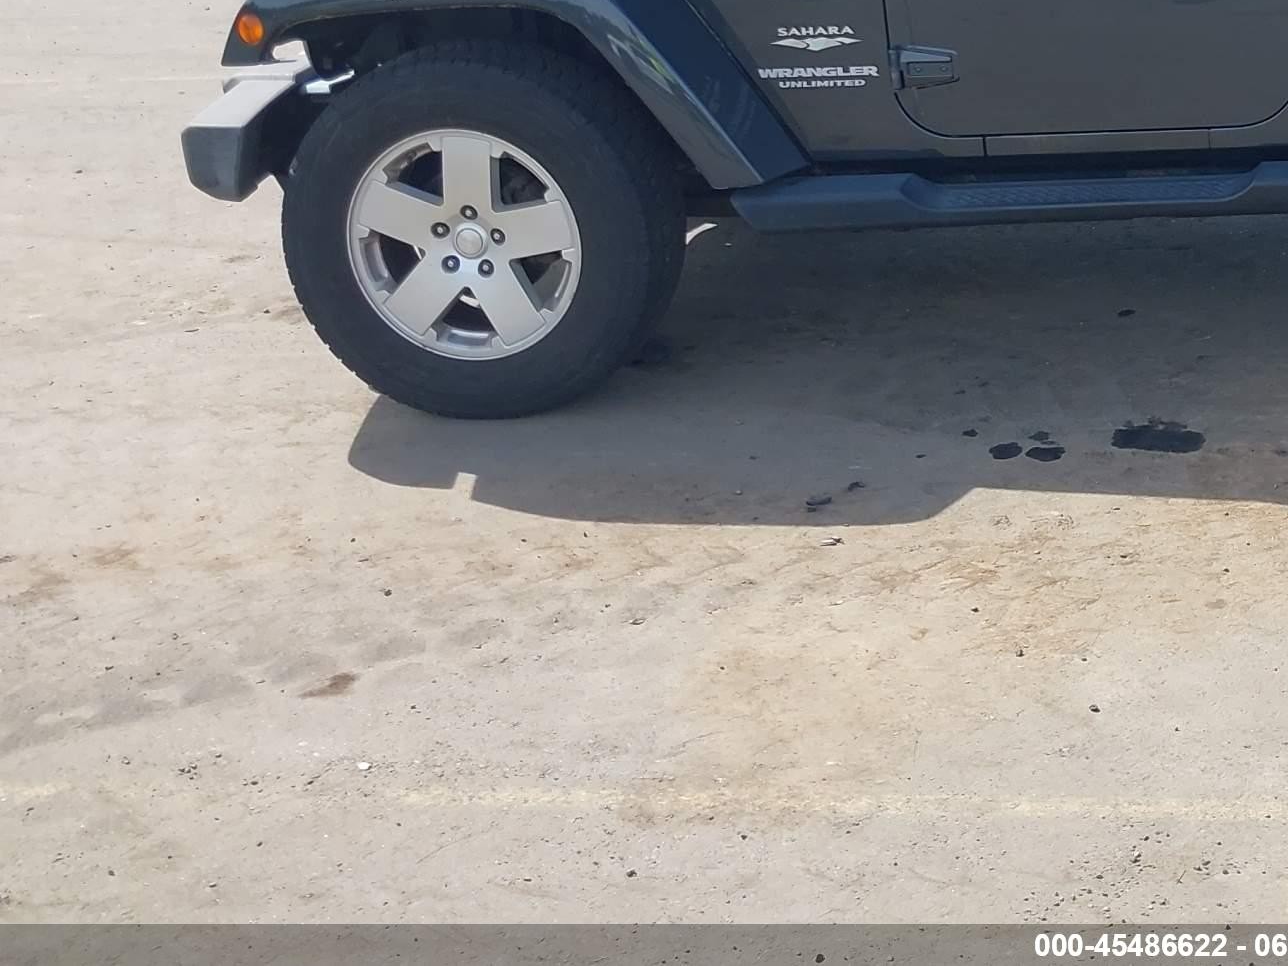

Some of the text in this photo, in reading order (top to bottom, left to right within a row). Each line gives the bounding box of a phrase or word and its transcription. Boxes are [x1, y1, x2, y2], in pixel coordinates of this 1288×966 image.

[777, 26, 854, 37] SAHARA
[758, 65, 880, 78] WRANGLER
[779, 79, 866, 89] UNLIMITED
